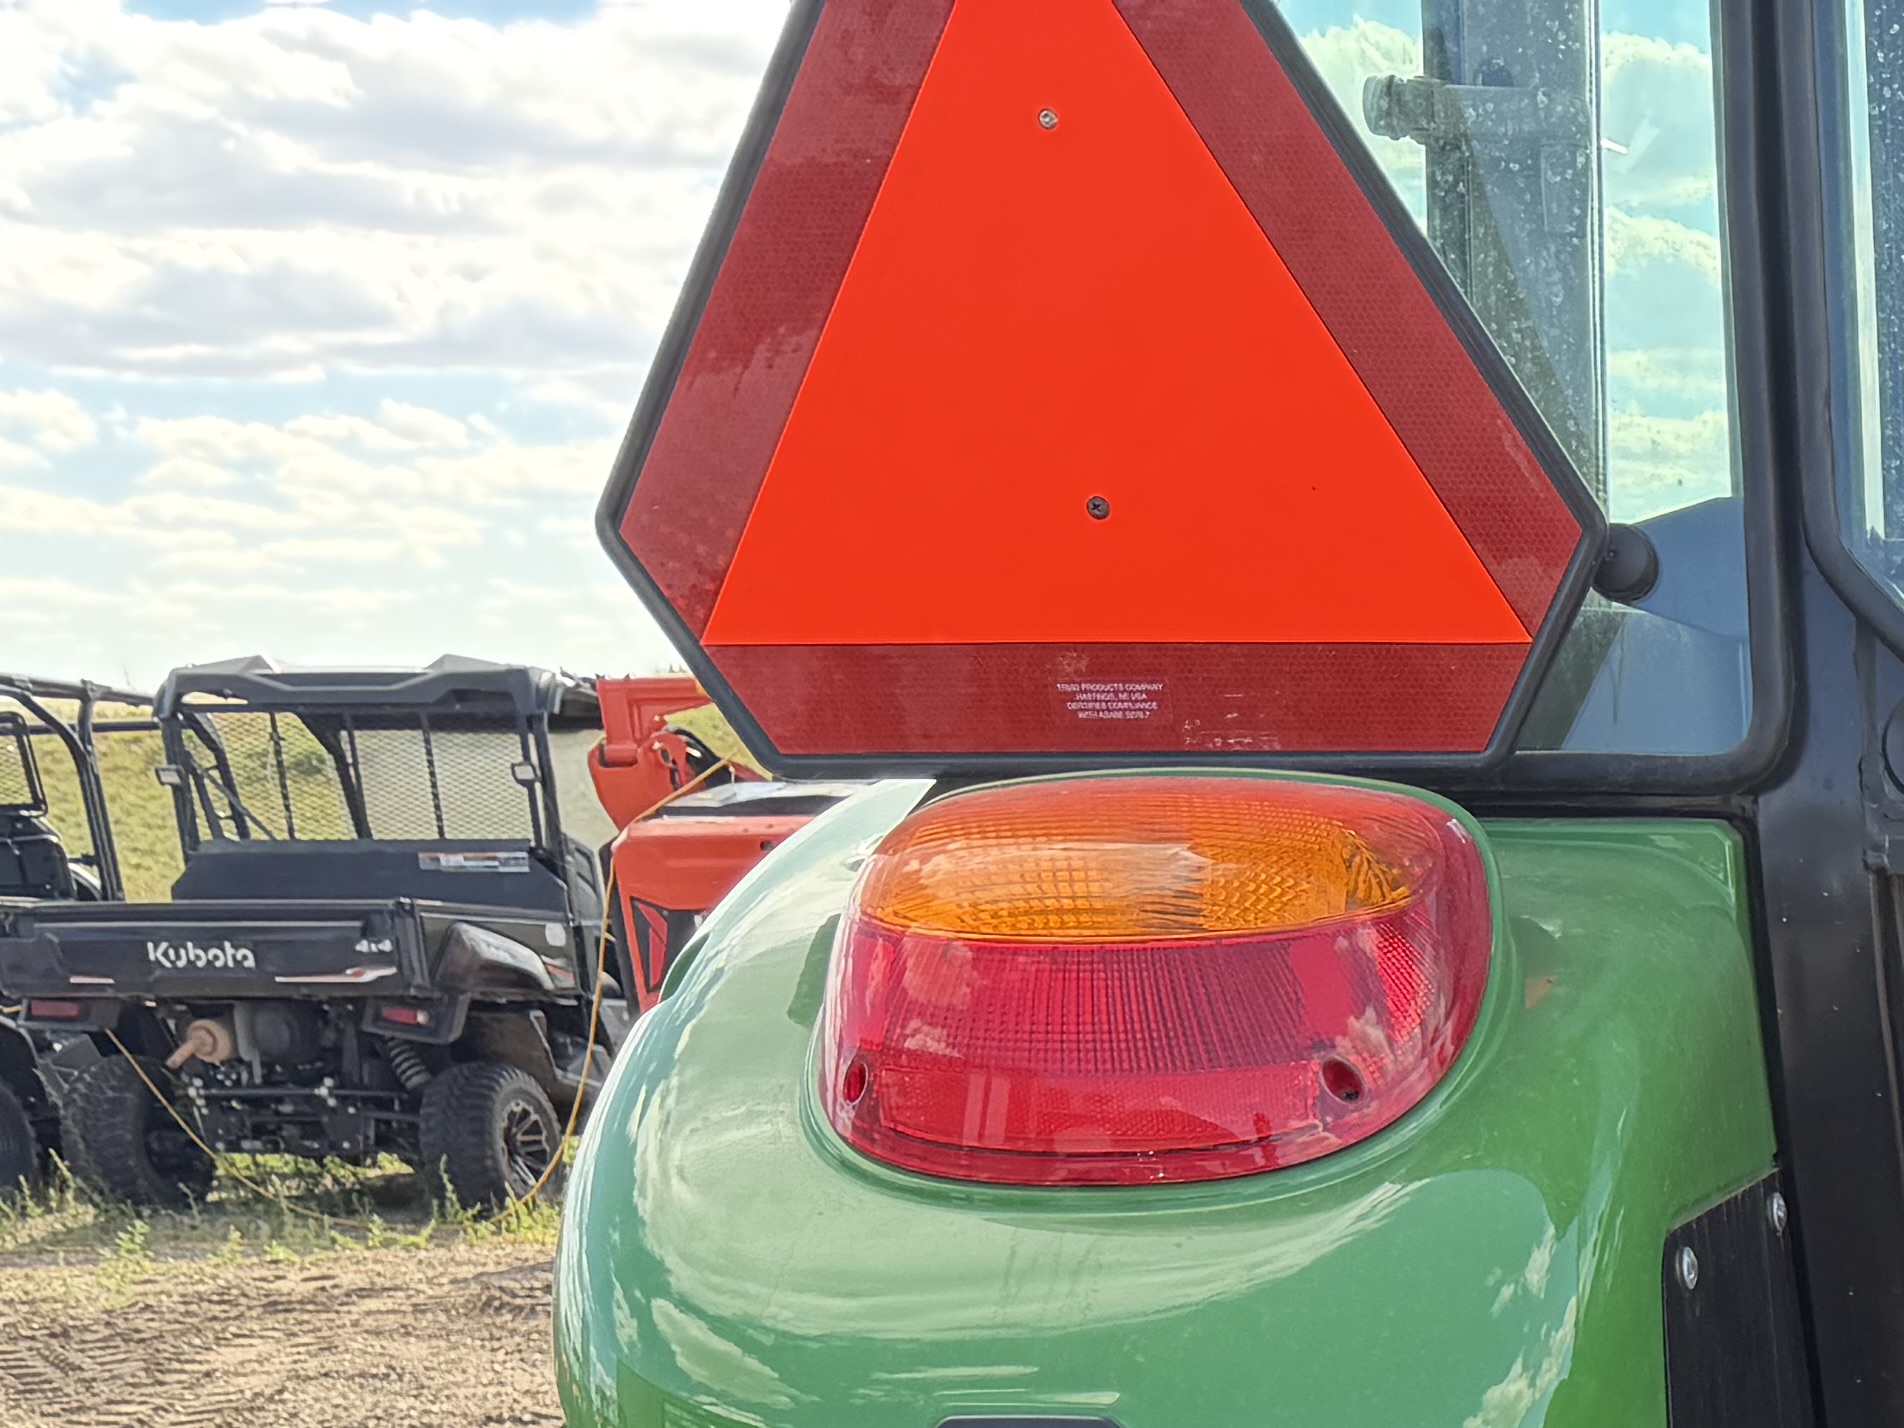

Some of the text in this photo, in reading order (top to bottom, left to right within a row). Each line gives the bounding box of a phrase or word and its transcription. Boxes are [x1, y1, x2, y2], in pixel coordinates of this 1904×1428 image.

[1081, 683, 1124, 692] PRODUCTS
[1125, 683, 1164, 691] COMPANY
[147, 940, 256, 969] Kubota
